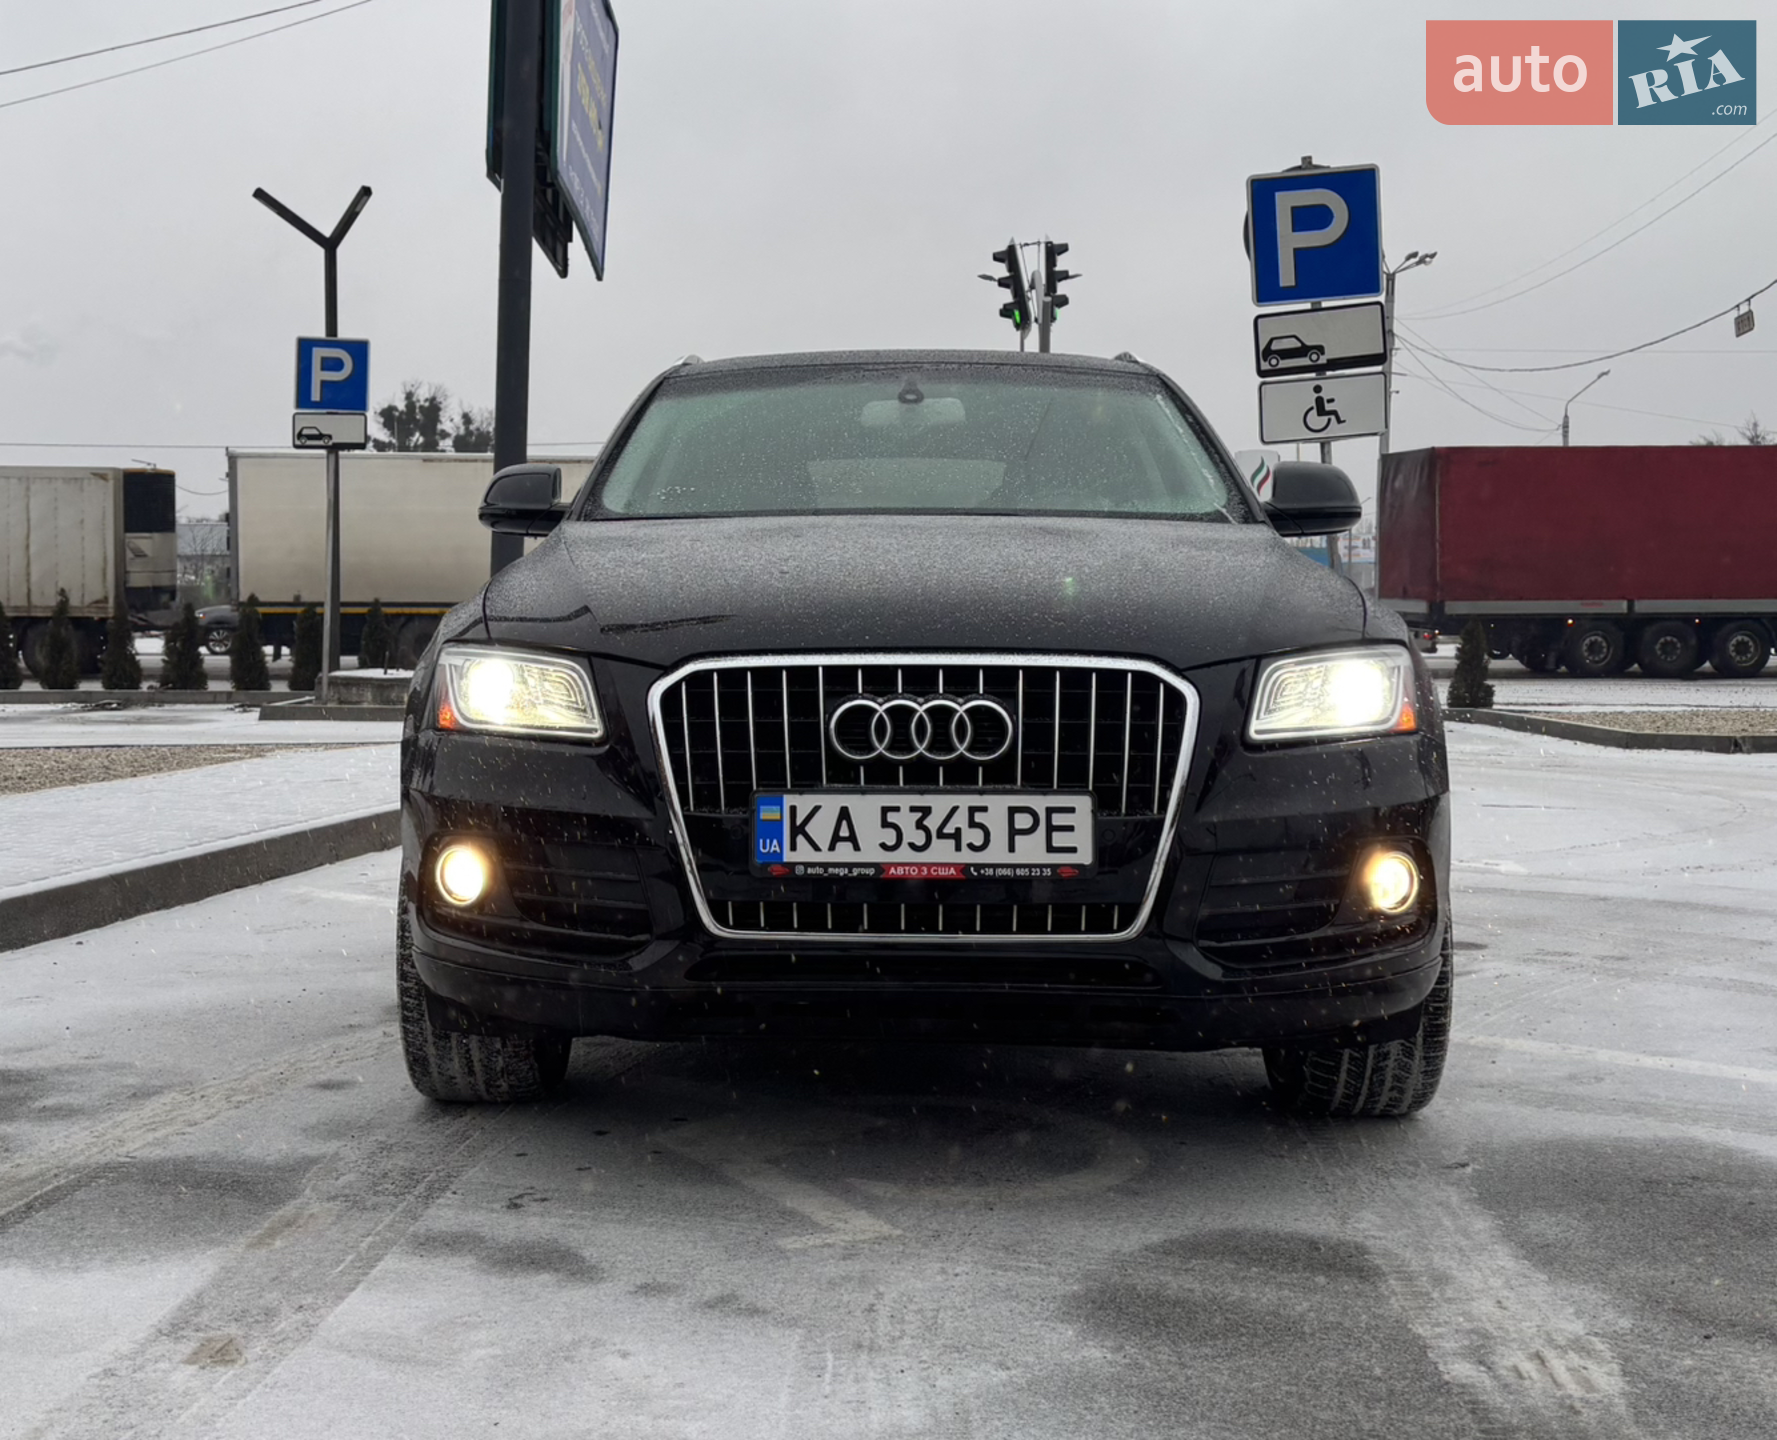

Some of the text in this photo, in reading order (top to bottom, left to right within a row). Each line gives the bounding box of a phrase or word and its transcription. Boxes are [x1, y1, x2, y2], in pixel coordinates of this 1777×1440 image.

[1274, 188, 1350, 287] P
[310, 346, 354, 402] P
[788, 804, 1079, 854] KA 5345 PE
[759, 839, 781, 854] UA
[806, 866, 876, 877] auto_mega_group
[888, 866, 919, 876] АВТО
[930, 866, 957, 876] США
